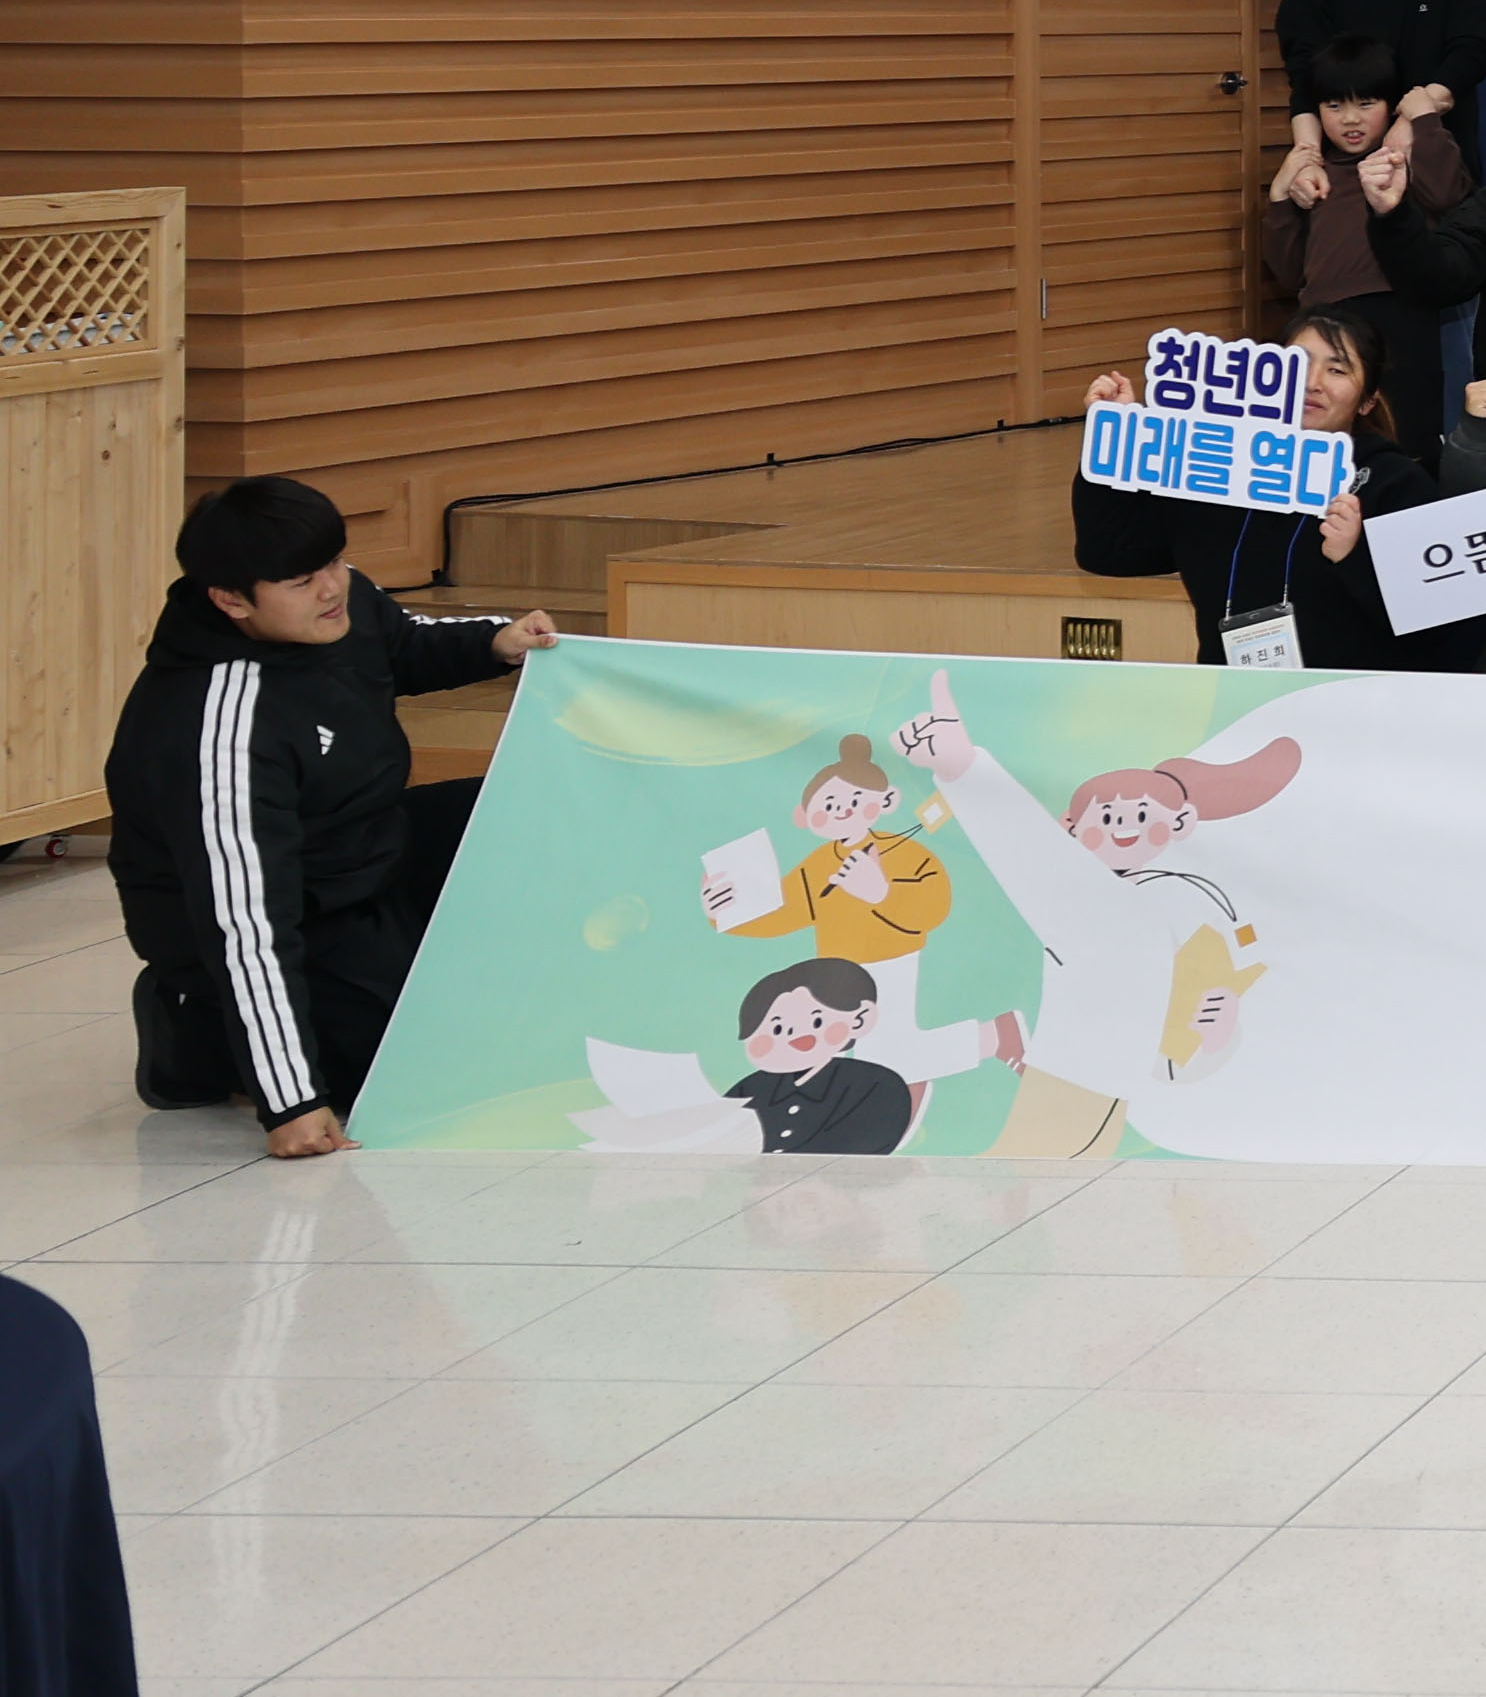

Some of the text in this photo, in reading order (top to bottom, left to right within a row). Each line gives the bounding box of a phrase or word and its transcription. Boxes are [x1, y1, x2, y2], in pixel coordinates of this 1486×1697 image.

[1153, 334, 1300, 427] 청년의
[1087, 408, 1350, 509] 미래를 열다
